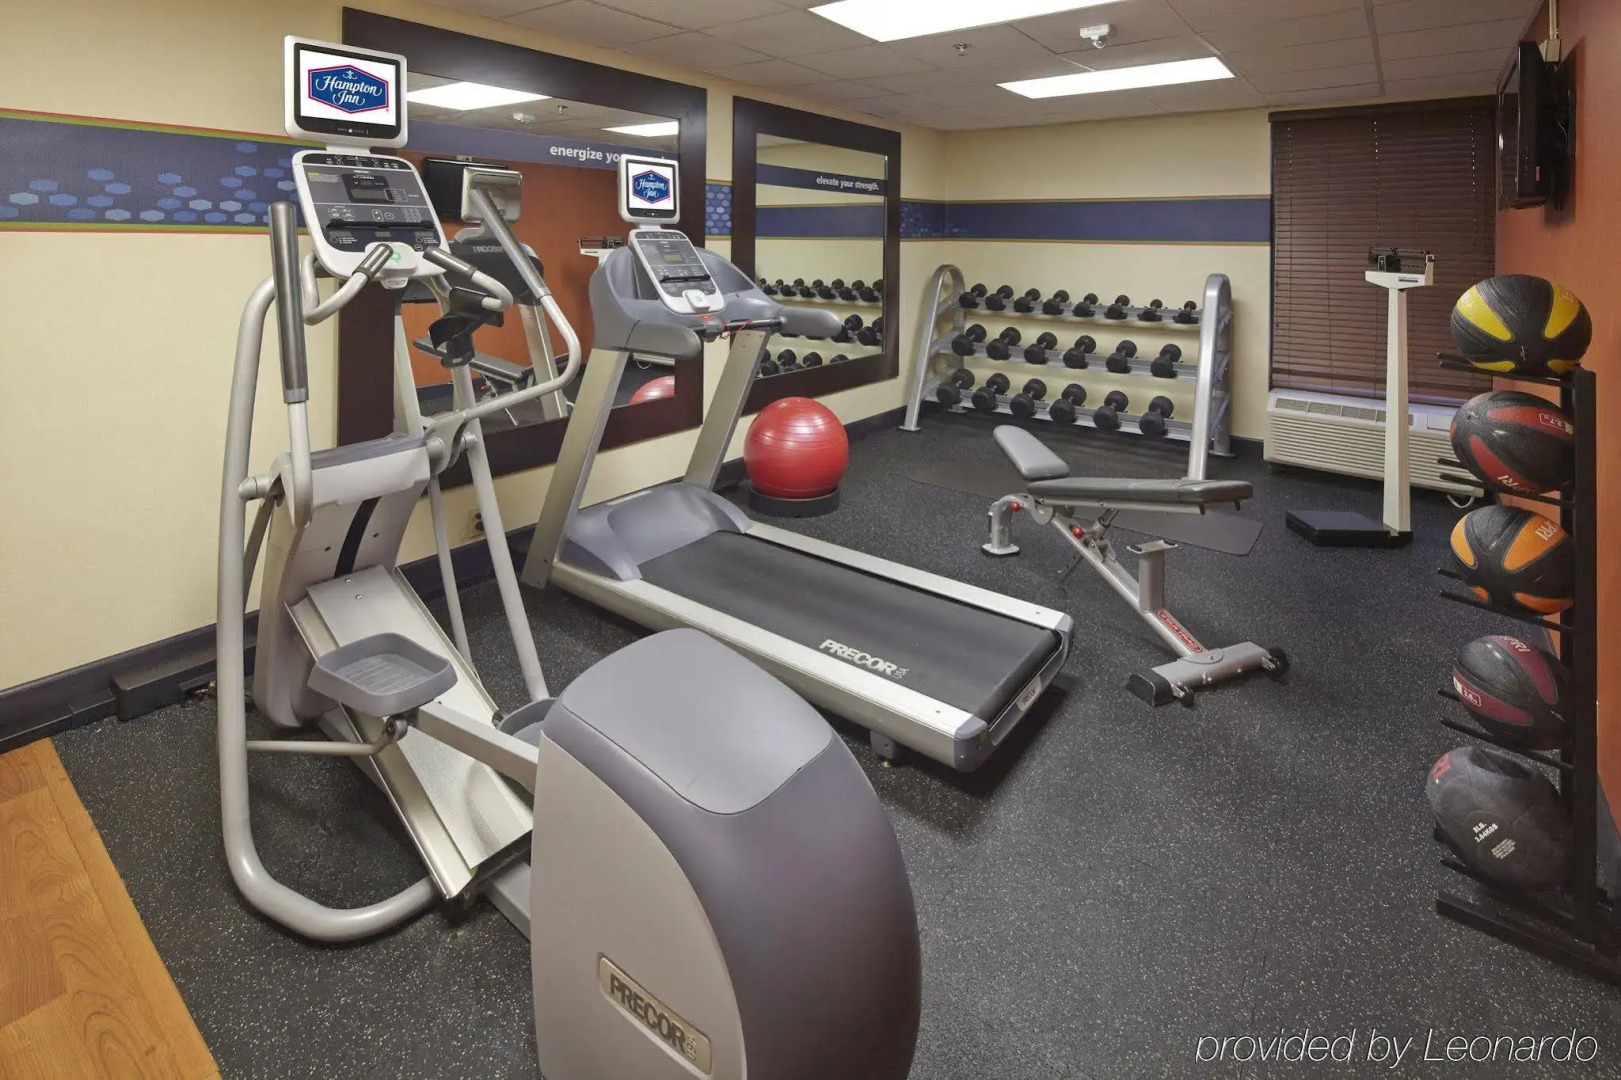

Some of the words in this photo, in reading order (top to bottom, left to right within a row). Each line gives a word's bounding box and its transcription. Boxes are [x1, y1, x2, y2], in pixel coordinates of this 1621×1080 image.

[315, 75, 382, 97] Hampton
[333, 91, 365, 106] Inn
[550, 145, 603, 161] energize
[635, 178, 667, 190] Hampton
[816, 176, 839, 187] elevate
[840, 180, 854, 189] your
[643, 189, 659, 198] Inn
[819, 639, 898, 676] PRECOR
[610, 972, 685, 1053] PRECOR
